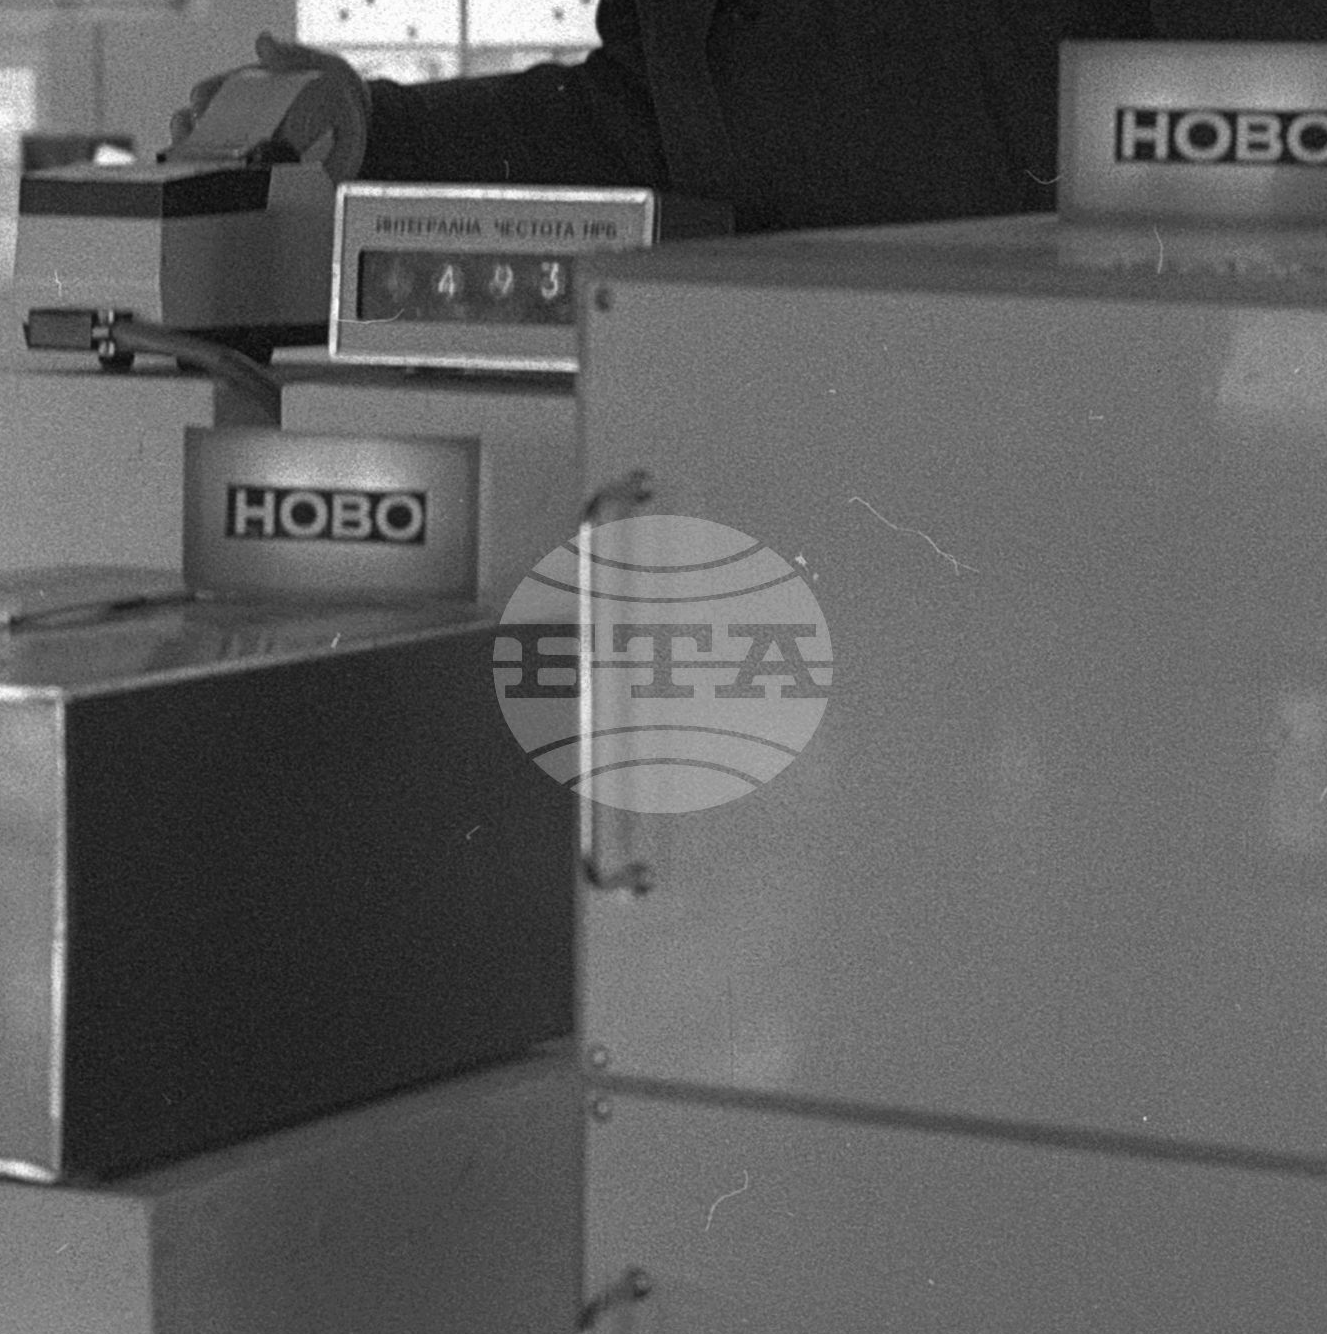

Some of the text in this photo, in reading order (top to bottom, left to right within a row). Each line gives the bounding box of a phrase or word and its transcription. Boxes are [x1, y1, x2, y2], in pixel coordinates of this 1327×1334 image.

[375, 215, 482, 234] ИНТЕГРАЛНА
[493, 218, 575, 237] ЧЕСТОТА
[234, 488, 424, 542] НОВО
